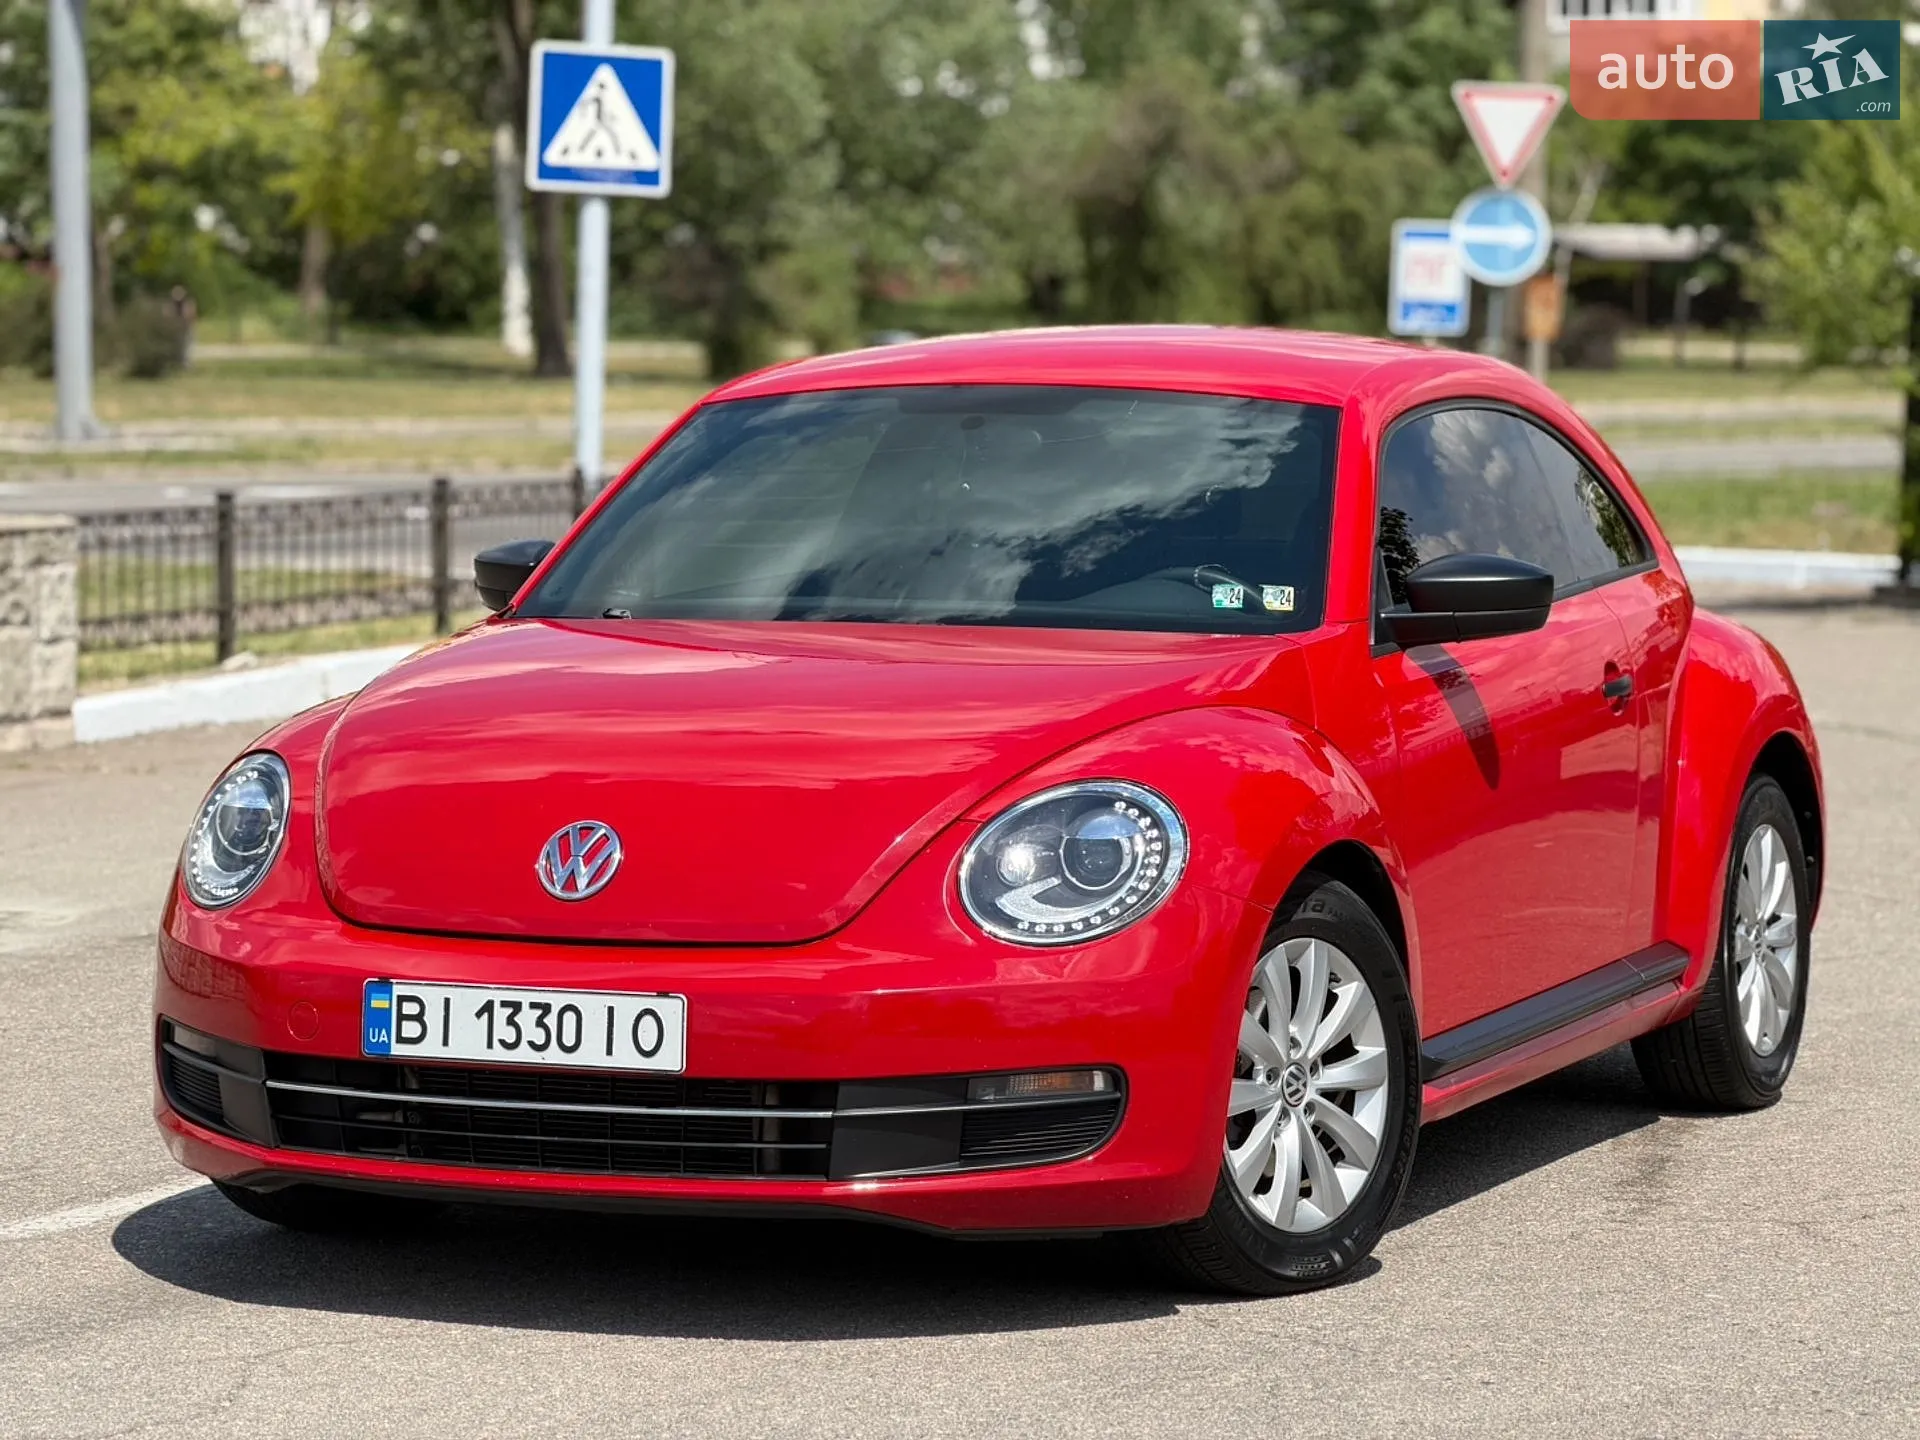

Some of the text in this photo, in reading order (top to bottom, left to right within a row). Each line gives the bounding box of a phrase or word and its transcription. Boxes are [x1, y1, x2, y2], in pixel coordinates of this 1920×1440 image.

[1229, 587, 1242, 604] 24
[1279, 589, 1292, 606] 24
[540, 822, 620, 897] VW
[395, 994, 665, 1059] BI 1330 IO
[369, 1027, 389, 1044] UA
